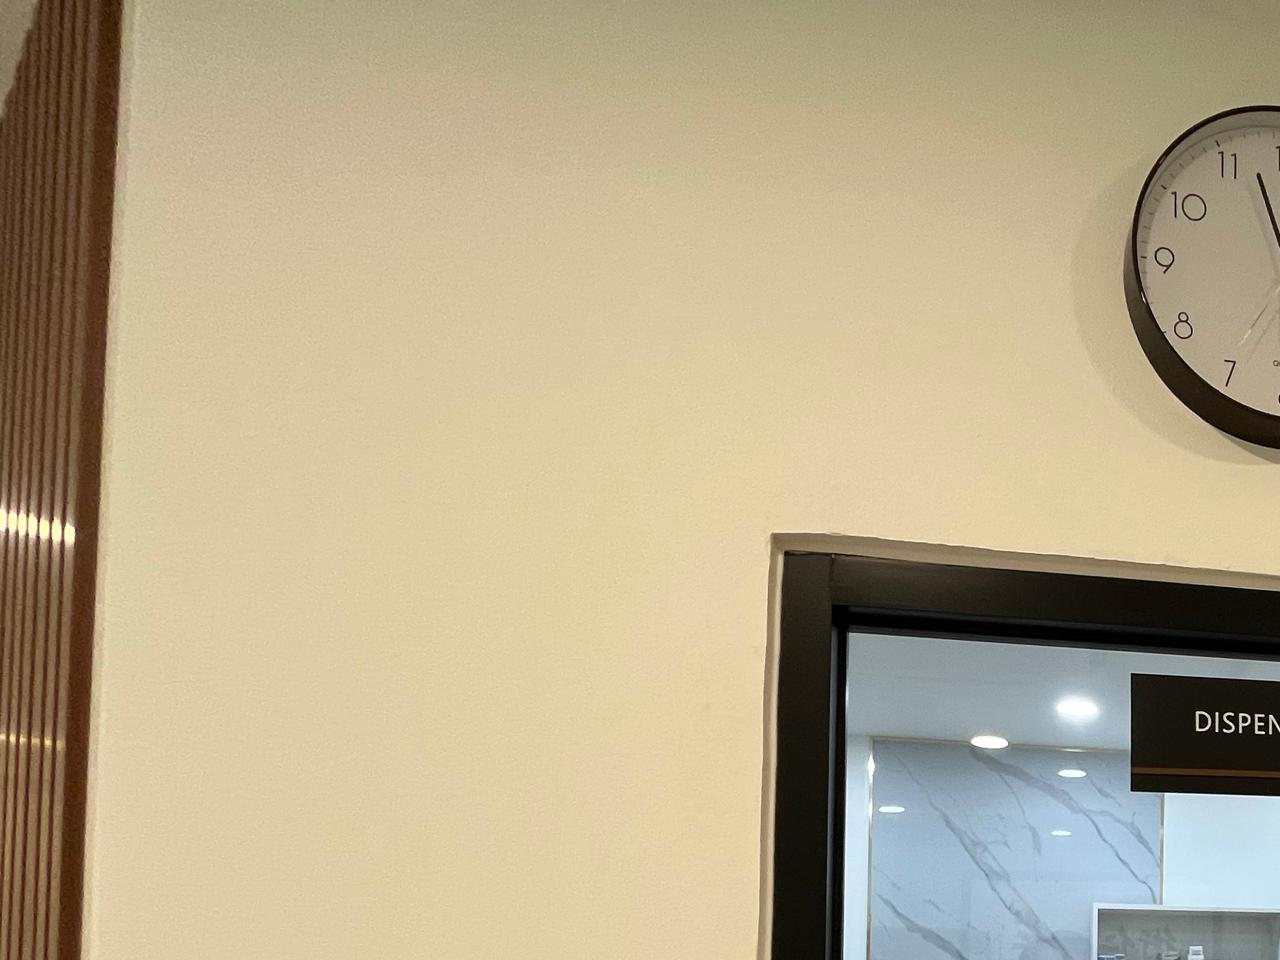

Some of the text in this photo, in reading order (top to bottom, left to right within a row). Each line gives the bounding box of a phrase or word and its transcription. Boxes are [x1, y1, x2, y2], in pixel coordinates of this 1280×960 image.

[1217, 150, 1238, 179] 11
[1171, 191, 1207, 221] 10
[1154, 247, 1175, 274] 9
[1173, 311, 1194, 339] 8
[1223, 359, 1237, 387] 7
